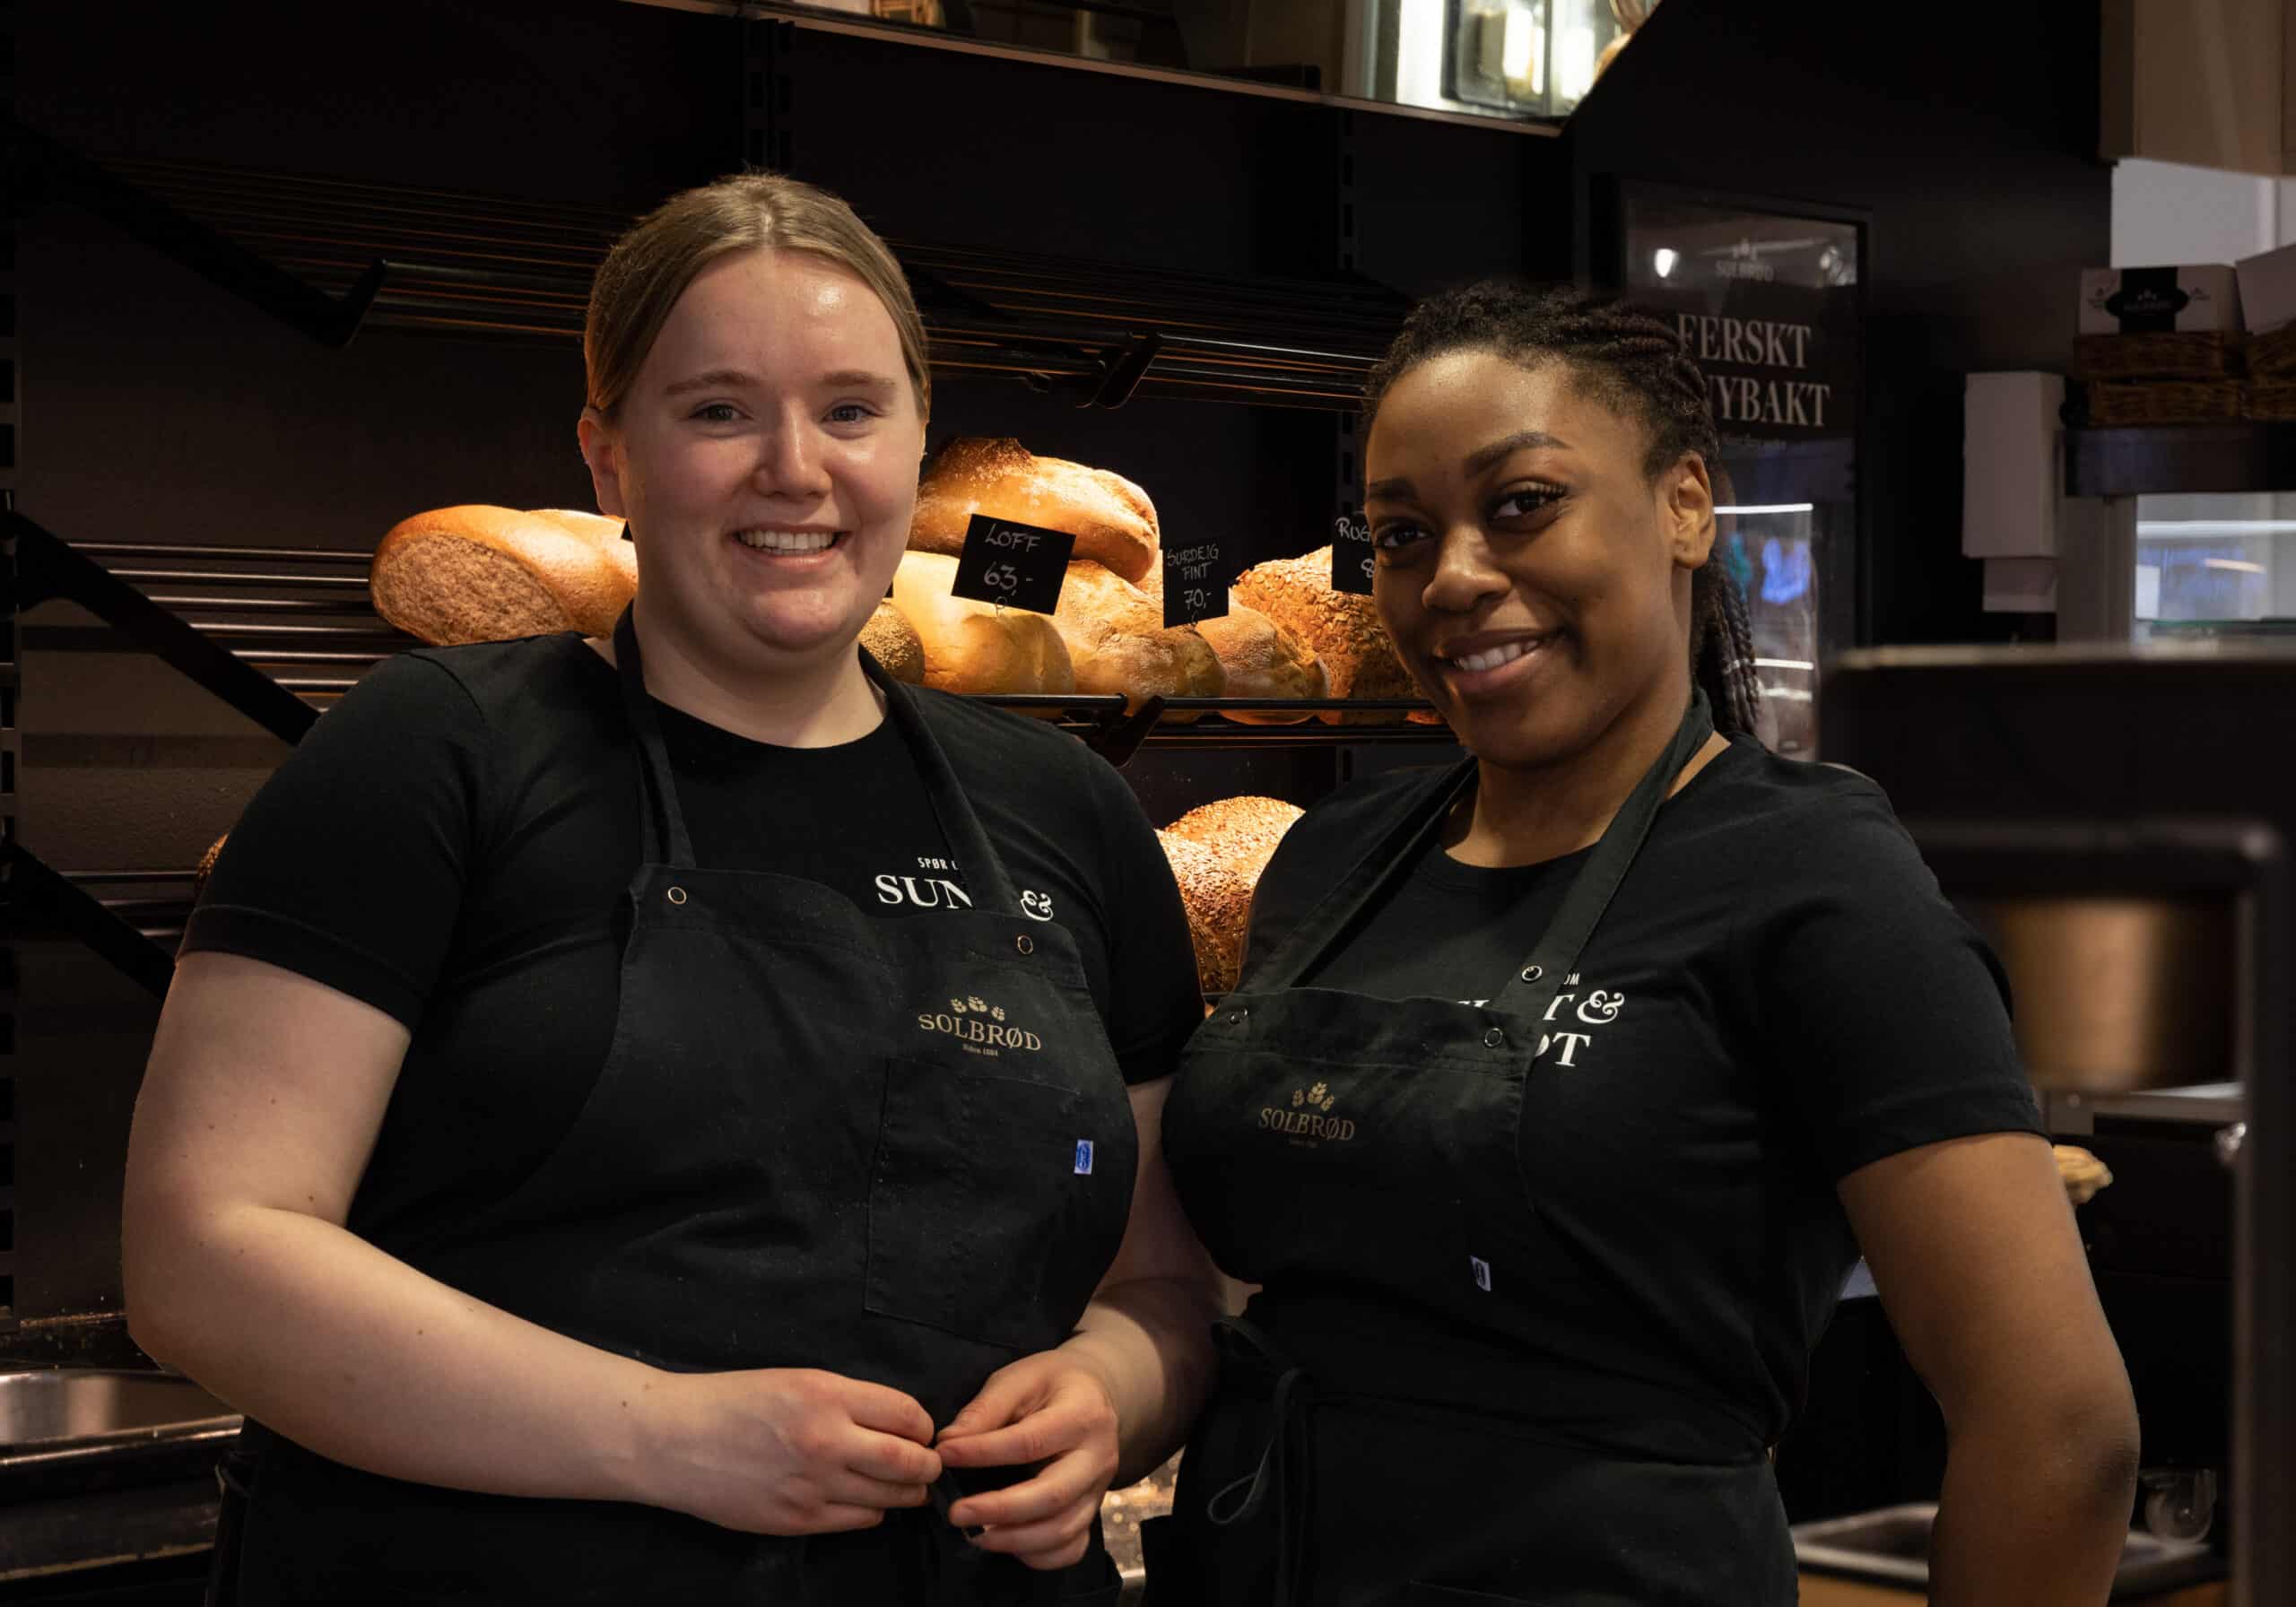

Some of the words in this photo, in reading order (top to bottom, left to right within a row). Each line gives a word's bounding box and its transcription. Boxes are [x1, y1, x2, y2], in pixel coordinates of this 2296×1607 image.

[1678, 314, 1812, 369] FERSKT
[1707, 374, 1831, 428] YBAKT
[984, 523, 1040, 552] LOFF
[1167, 543, 1220, 567] SURDEIG
[1181, 560, 1213, 581] FINT
[874, 873, 974, 909] SUN
[1020, 890, 1054, 922] &
[1576, 989, 1625, 1024] &
[918, 1013, 1042, 1051] SOLBRØD
[1257, 1107, 1356, 1142] SOLBRØD
